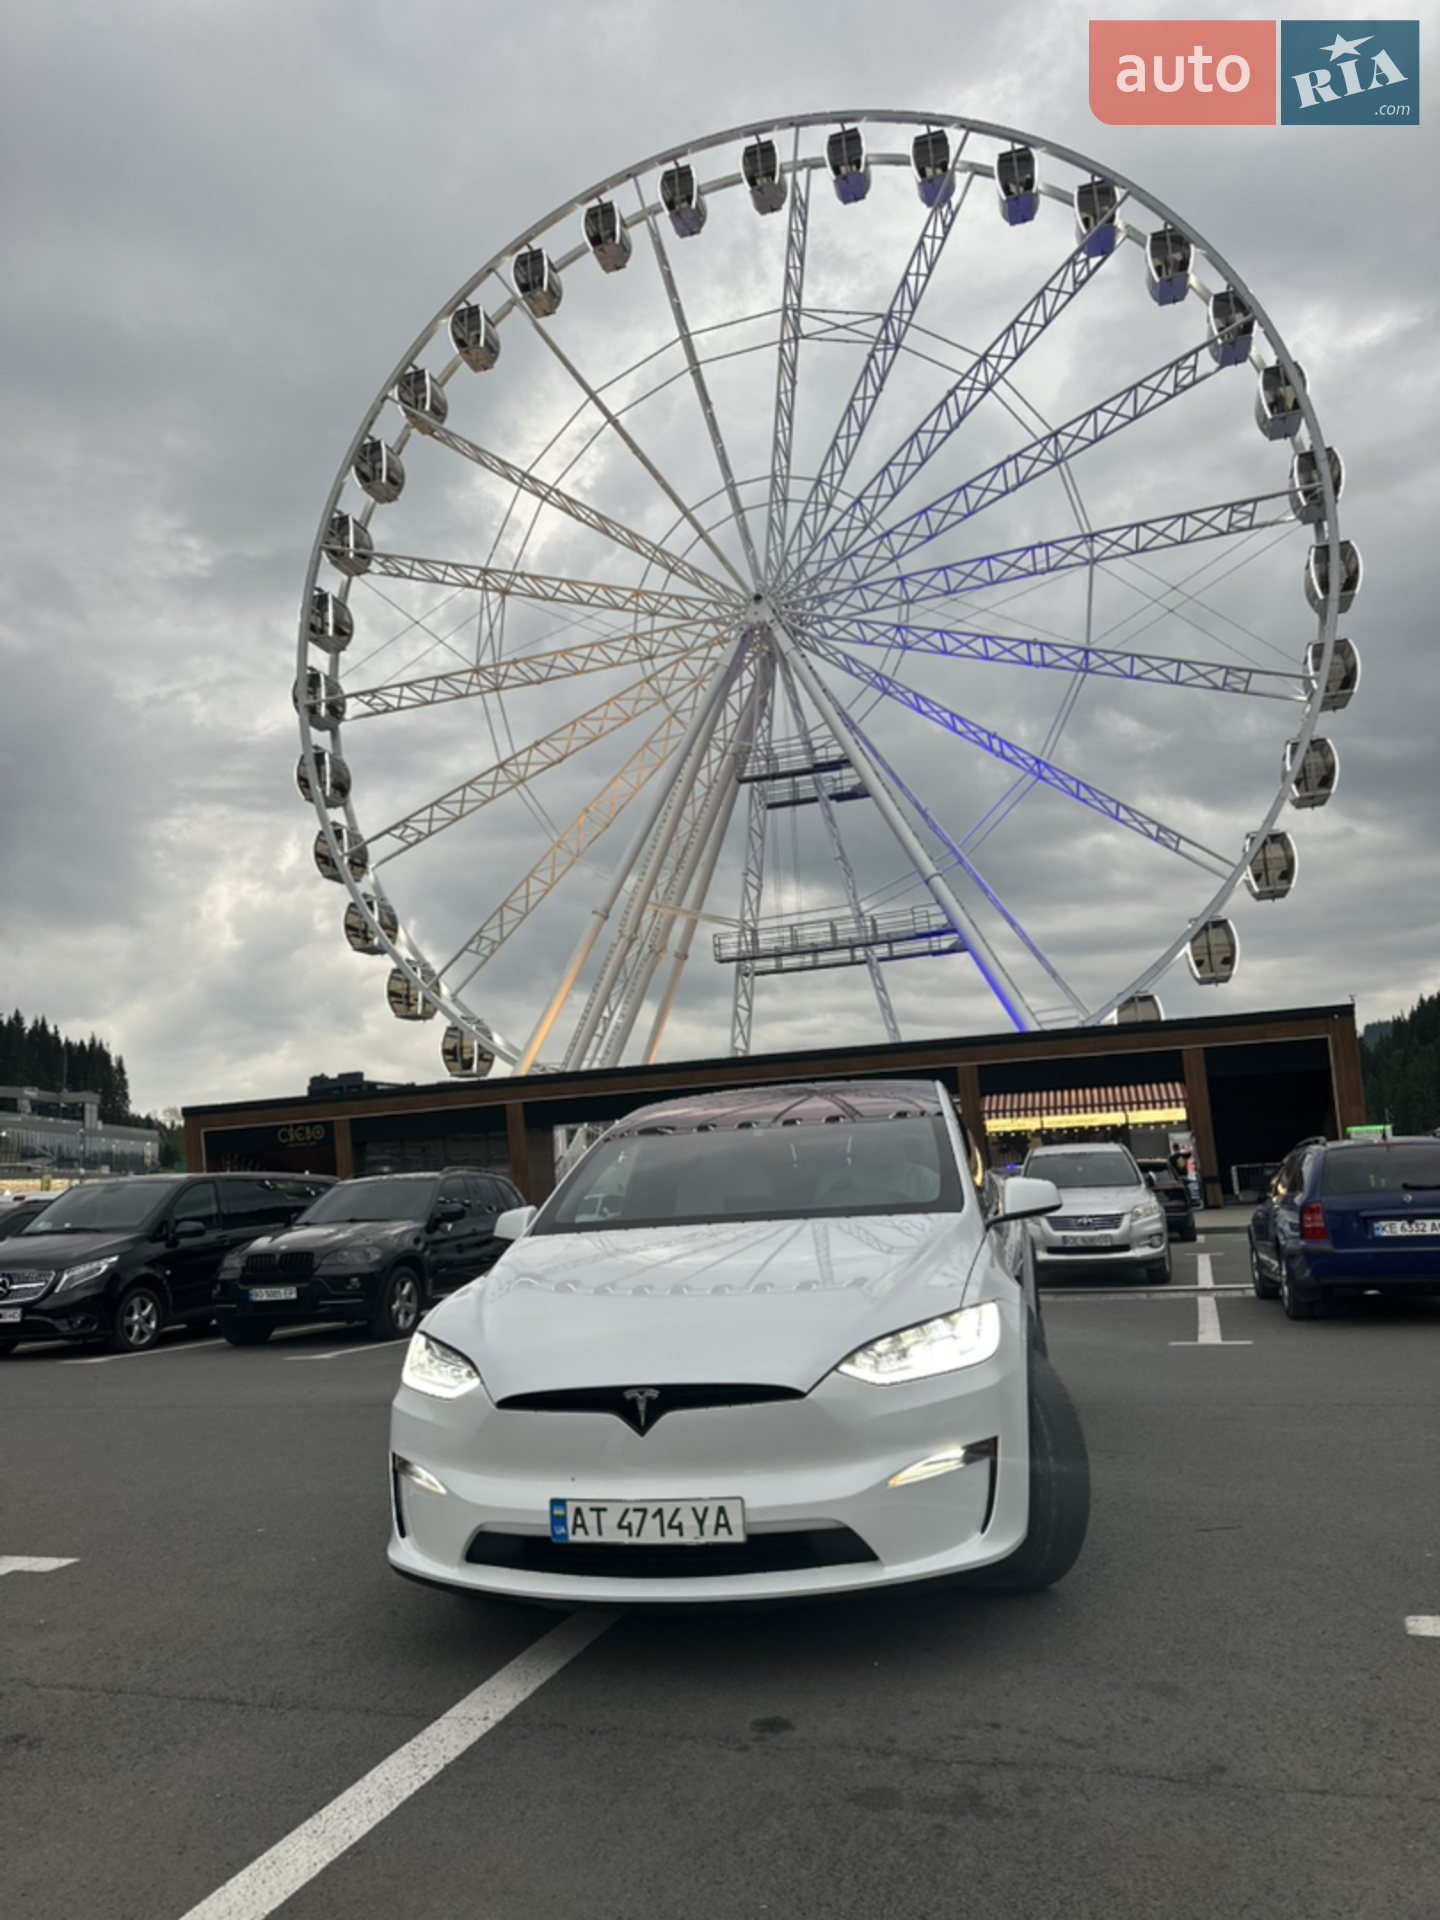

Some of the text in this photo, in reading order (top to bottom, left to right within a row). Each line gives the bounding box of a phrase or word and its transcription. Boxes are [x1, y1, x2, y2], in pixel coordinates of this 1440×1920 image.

[571, 1505, 733, 1538] AT 4714 YA
